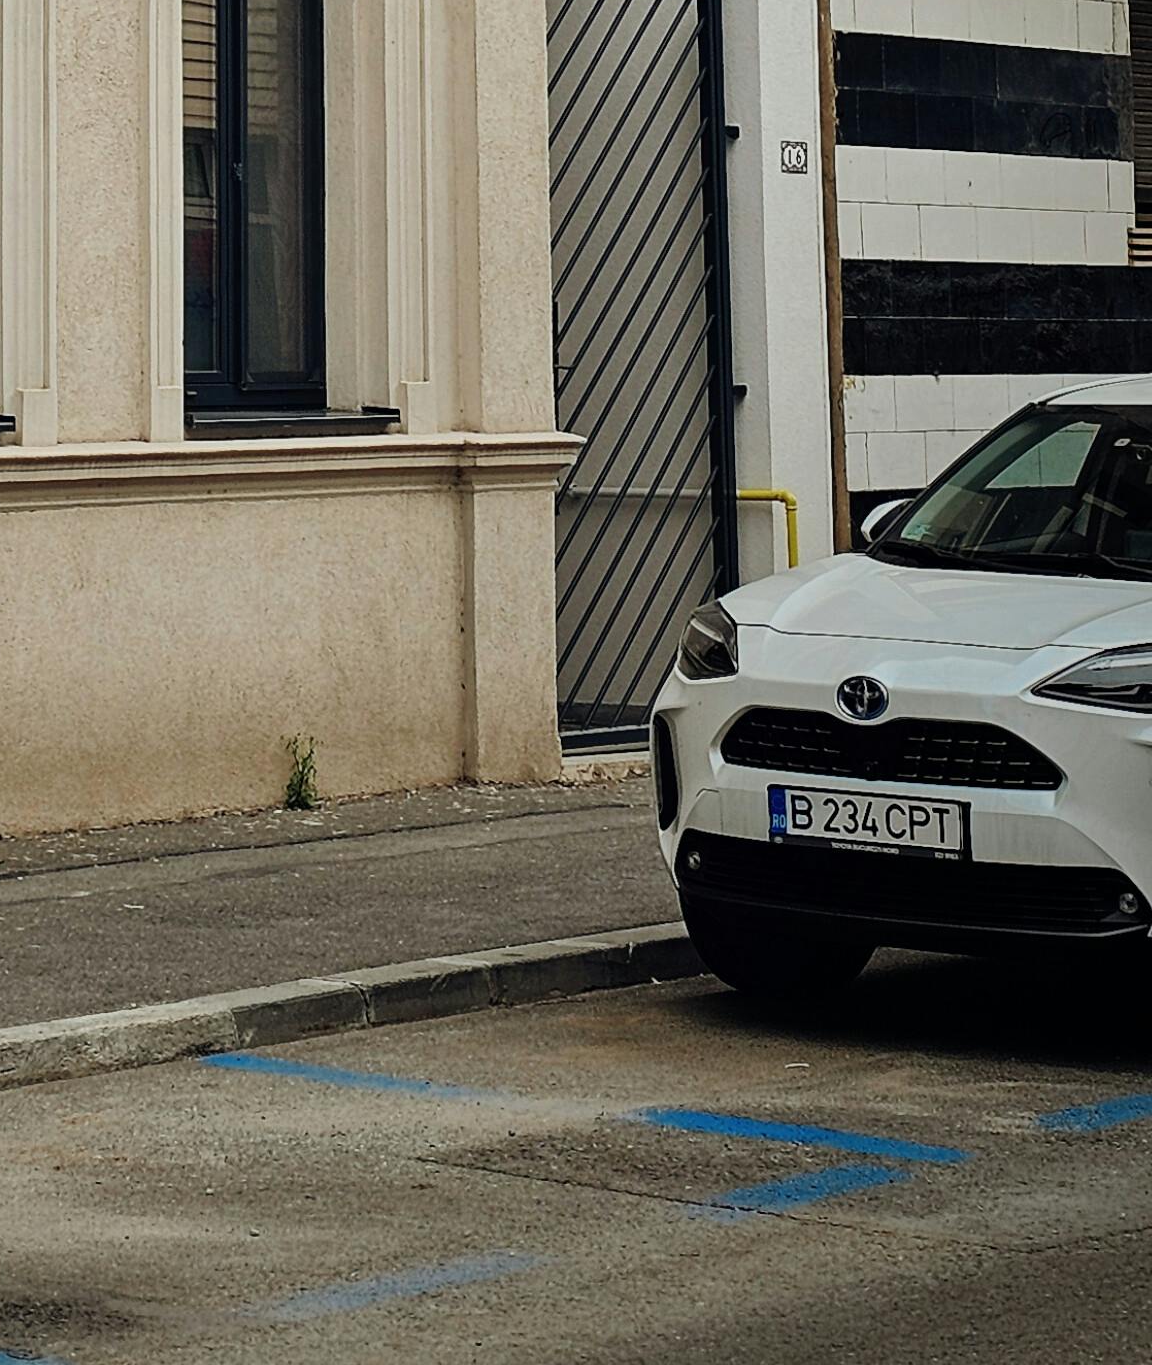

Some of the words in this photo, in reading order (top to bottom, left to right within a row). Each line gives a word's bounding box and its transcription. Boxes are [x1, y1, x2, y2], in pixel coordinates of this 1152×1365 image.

[788, 149, 802, 165] 16
[772, 813, 786, 828] RO
[790, 794, 813, 830] B
[822, 798, 879, 837] 234
[885, 803, 951, 844] CPT
